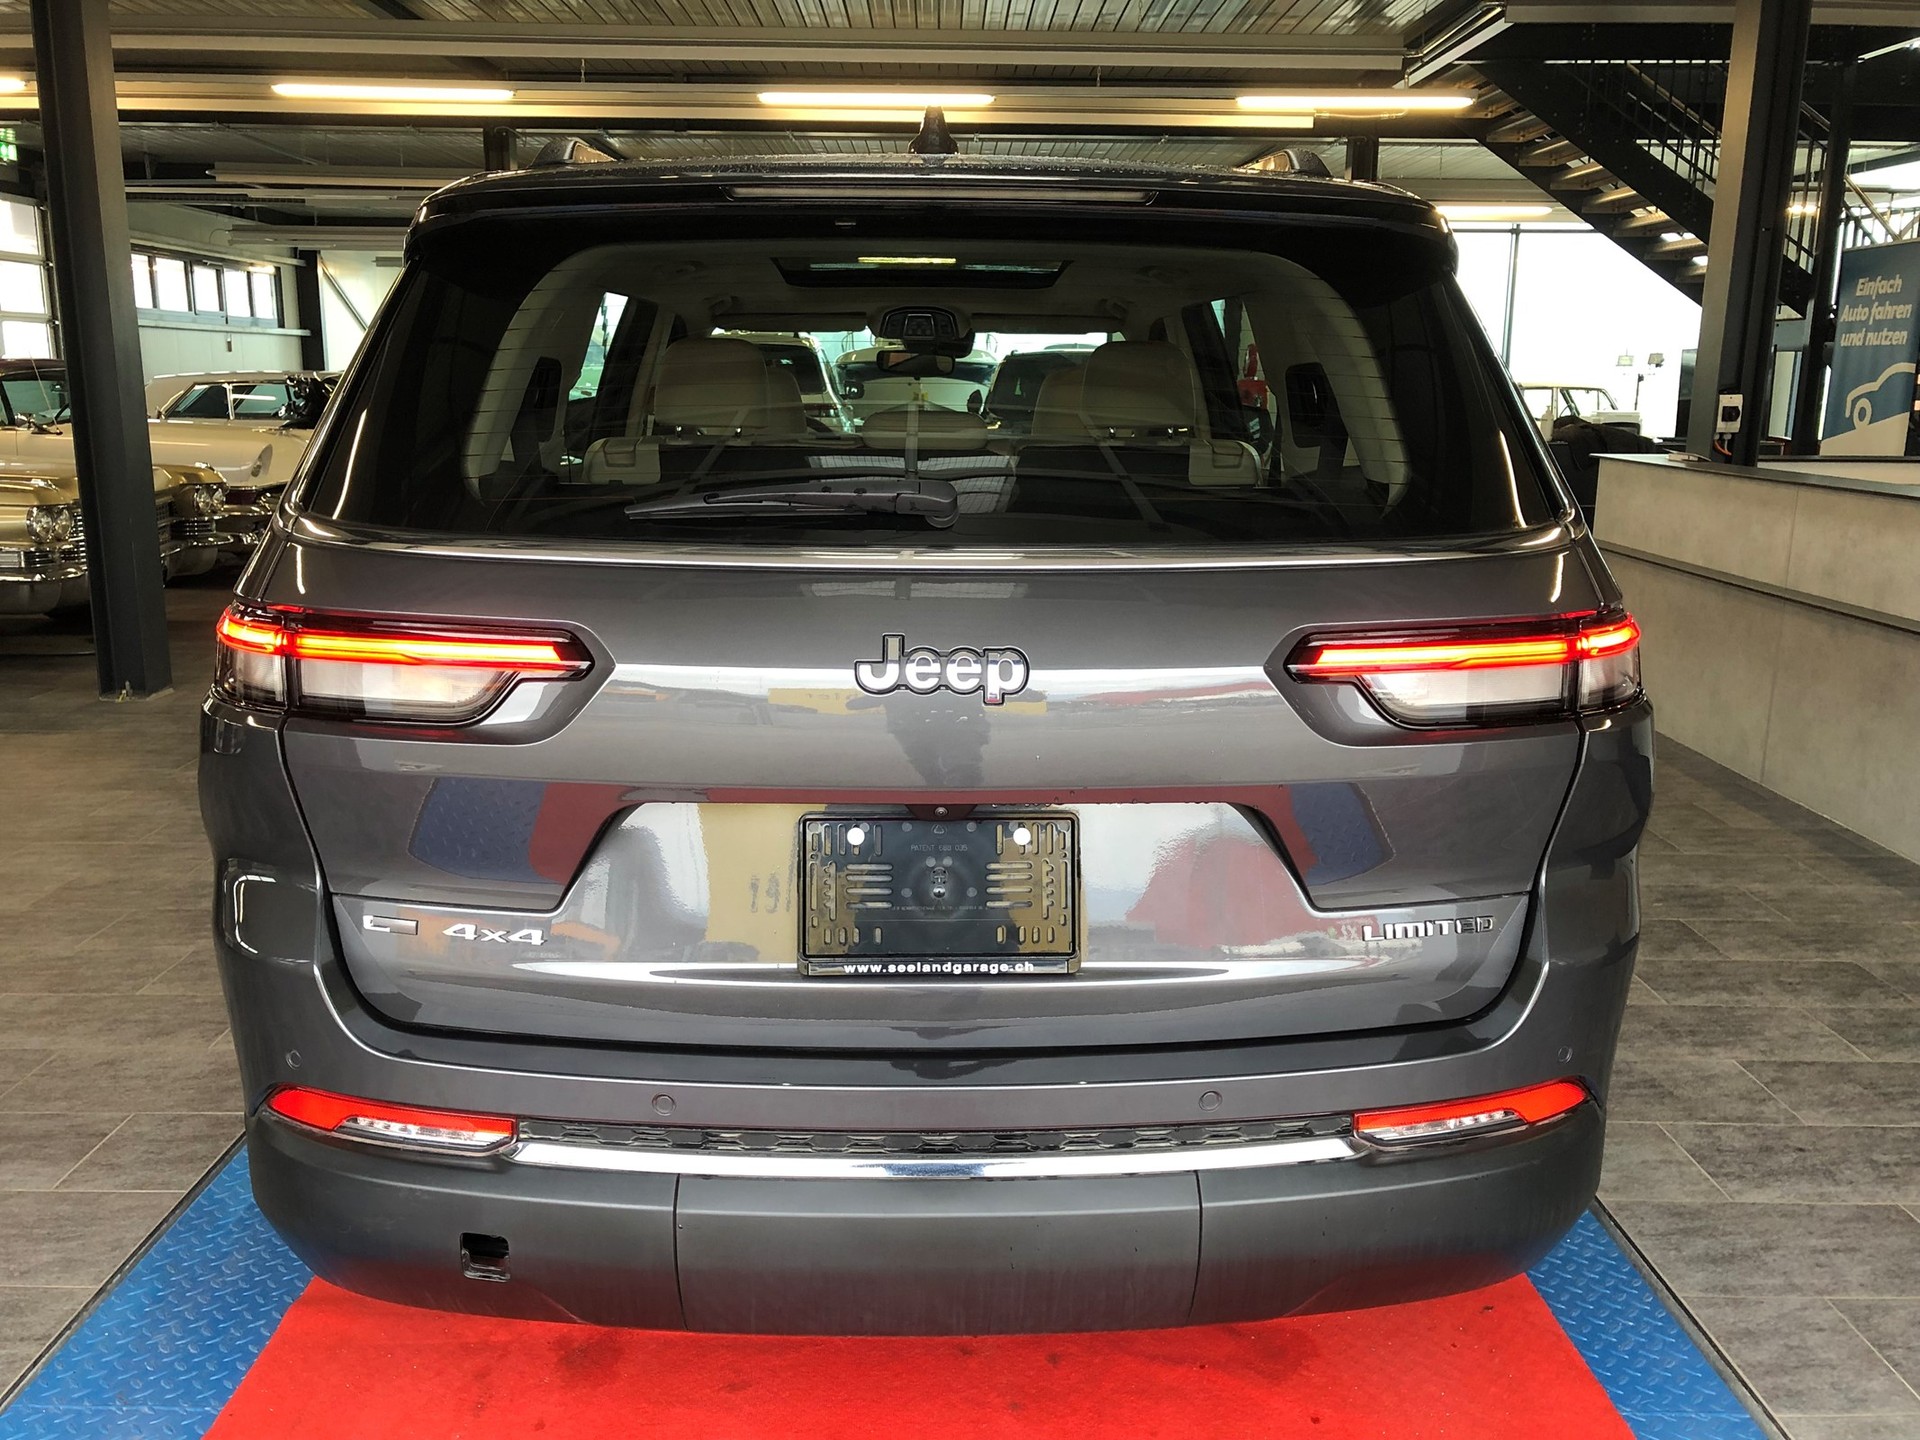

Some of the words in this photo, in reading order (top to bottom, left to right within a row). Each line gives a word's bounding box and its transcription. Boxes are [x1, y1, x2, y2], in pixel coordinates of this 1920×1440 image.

[1855, 274, 1903, 300] Einfach
[1840, 305, 1868, 323] Auto
[1868, 303, 1913, 325] fahren
[1840, 328, 1866, 347] und
[1866, 330, 1908, 346] nutzen
[855, 633, 1030, 706] Jeep
[442, 923, 547, 946] 4x4
[1362, 915, 1494, 942] LIMITED
[843, 961, 1035, 975] www.seelandgarage.ch
